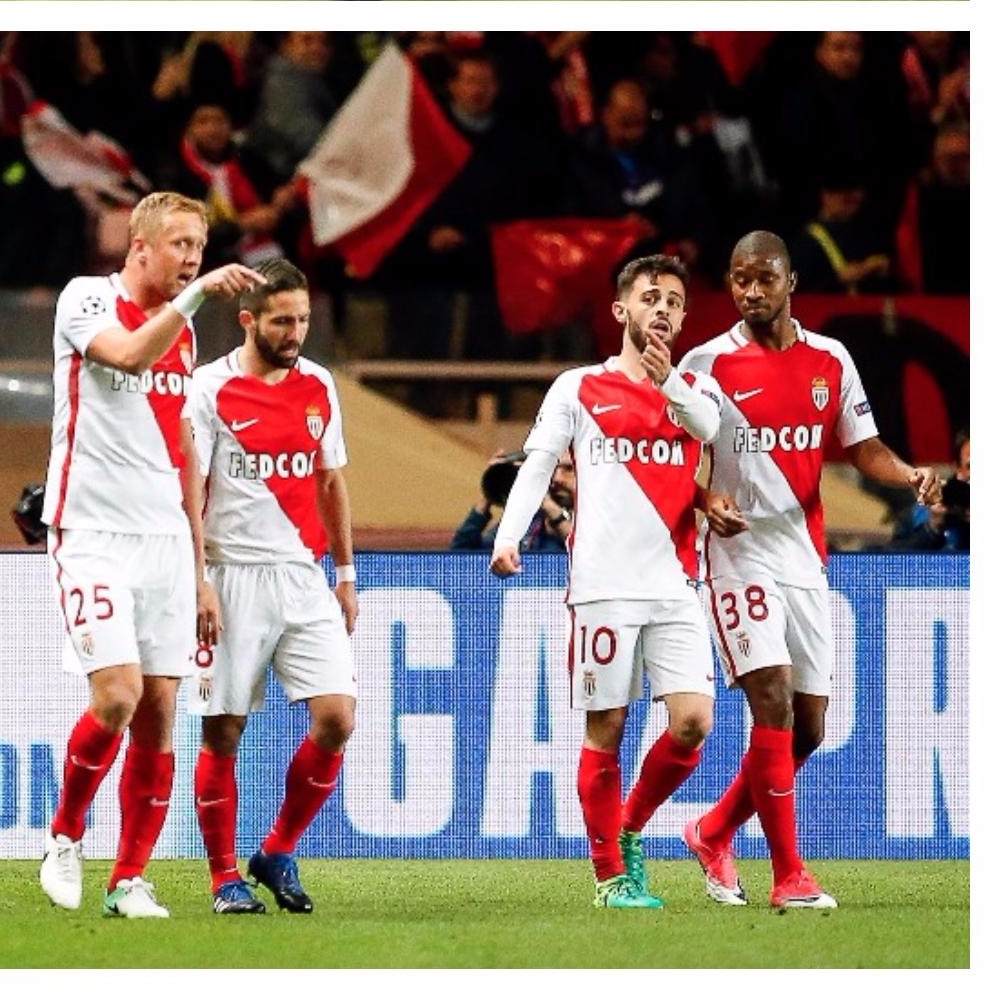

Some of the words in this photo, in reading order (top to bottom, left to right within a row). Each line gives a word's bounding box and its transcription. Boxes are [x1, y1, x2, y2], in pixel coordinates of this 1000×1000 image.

[111, 369, 187, 397] FEDCO
[70, 584, 114, 626] 25
[721, 585, 769, 631] 38
[580, 625, 617, 666] 10
